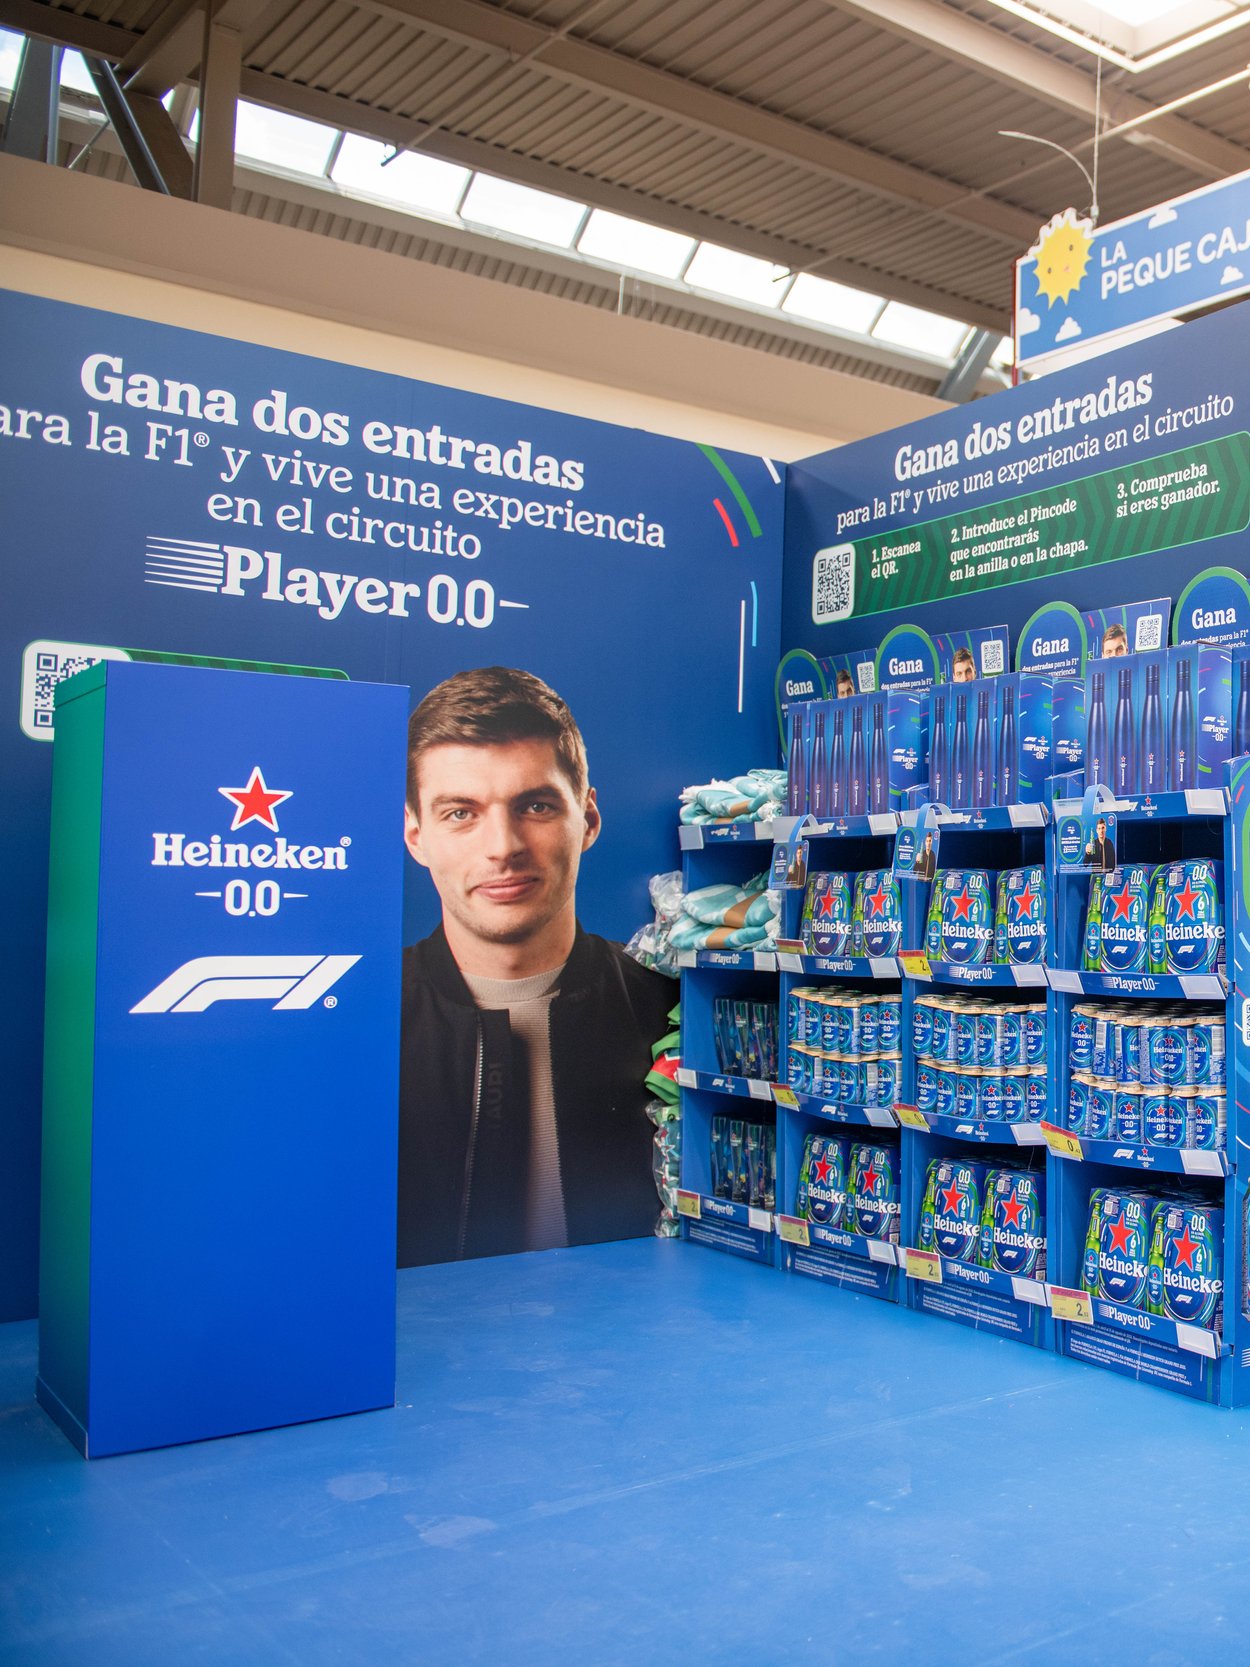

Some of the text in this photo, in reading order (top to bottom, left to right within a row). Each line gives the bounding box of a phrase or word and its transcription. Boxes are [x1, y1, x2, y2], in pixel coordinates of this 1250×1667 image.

[1101, 240, 1127, 268] LA
[1101, 240, 1192, 299] PEQUE
[81, 353, 584, 491] Gana dos entradas
[895, 373, 1152, 481] Gana dos entradas
[0, 405, 72, 446] ara
[86, 411, 130, 456] la
[220, 446, 251, 483] y
[262, 450, 353, 493] vive
[365, 472, 442, 509] una
[453, 489, 665, 548] experiencia
[836, 506, 870, 535] para
[873, 497, 887, 519] la
[913, 490, 924, 514] y
[926, 480, 959, 504] vive
[963, 470, 994, 494] una
[997, 434, 1100, 484] experiencia
[1104, 429, 1128, 451] en
[1133, 414, 1150, 443] el
[1155, 394, 1234, 436] circuito
[1117, 463, 1207, 499] 3. Comprueba
[1116, 480, 1220, 518] si eres ganador.
[207, 493, 481, 559] en el circuito
[951, 498, 1077, 543] 2. Introduce el Pincode
[872, 541, 921, 563] 1. Escanea
[949, 539, 1088, 581] en la anilla o en la chapa.
[950, 527, 1039, 565] que encontrarás
[221, 545, 420, 620] Player
[871, 560, 899, 579] el QR.
[1197, 896, 1205, 910] 6
[1165, 922, 1226, 940] Heineke
[1112, 976, 1142, 992] Player
